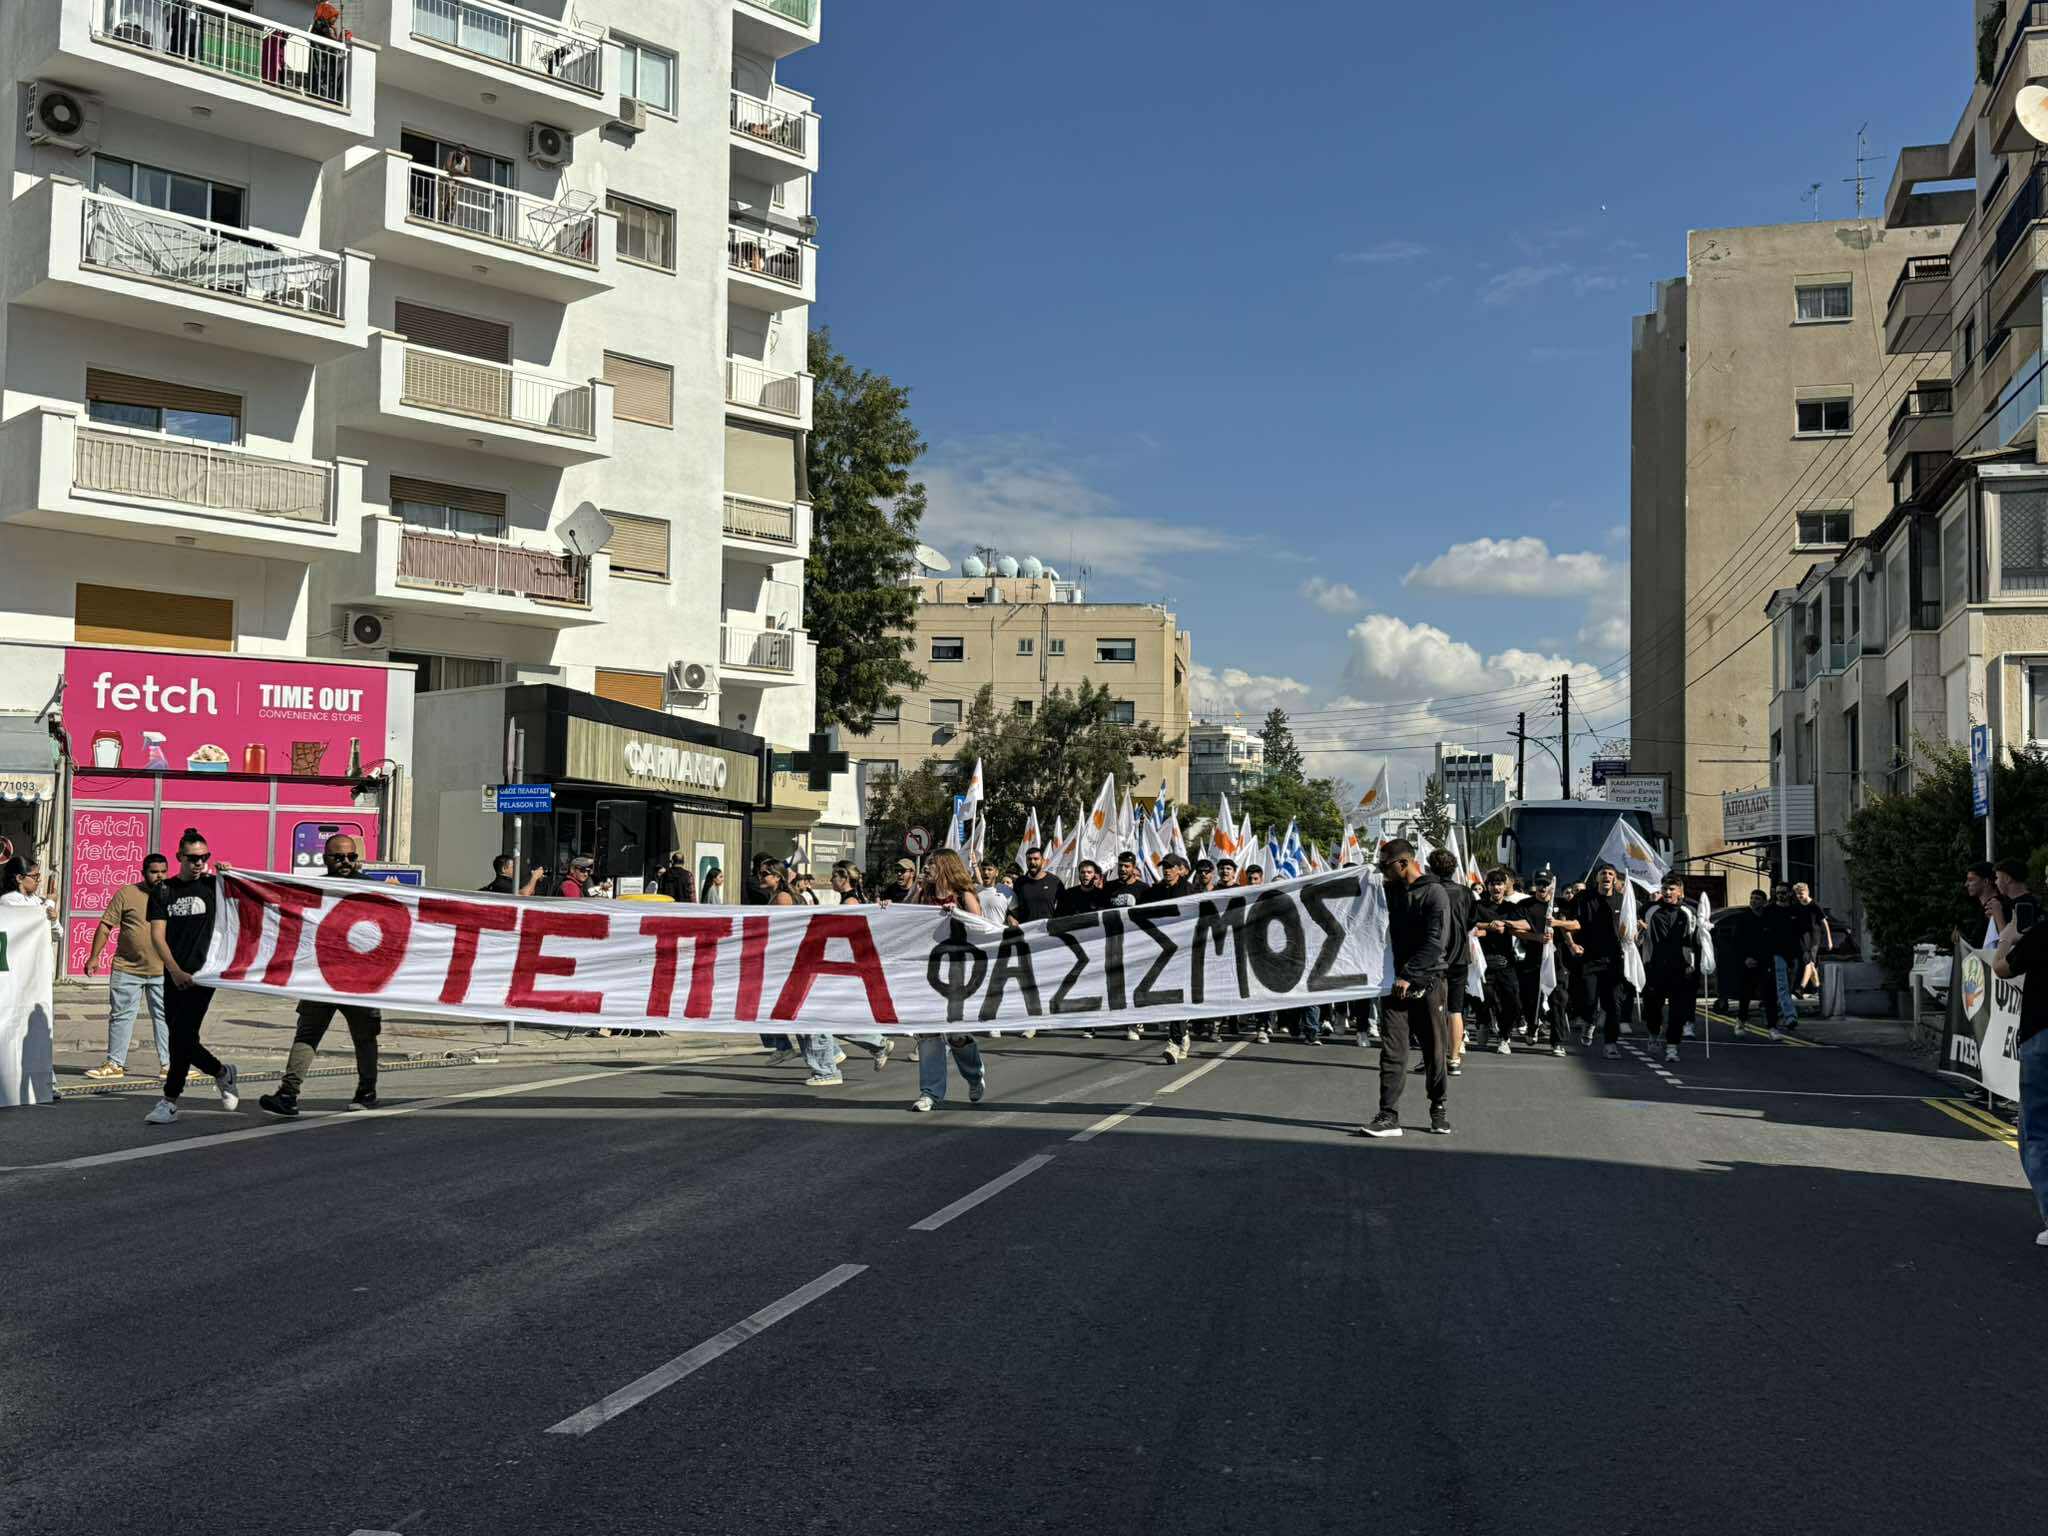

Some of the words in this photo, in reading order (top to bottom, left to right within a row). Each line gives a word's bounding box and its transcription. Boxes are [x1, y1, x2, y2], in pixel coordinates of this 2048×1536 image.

[93, 672, 217, 715] fetch
[260, 684, 314, 709] TIME
[320, 687, 363, 711] OUT
[259, 709, 329, 721] CONVENIENCE
[331, 712, 363, 722] STORE
[1725, 794, 1769, 817] ΑΠΟΛΛΩΝ
[78, 814, 144, 837] fetch
[77, 839, 143, 861] fetch
[220, 872, 610, 1012] ΠΟΤΕ
[641, 914, 898, 1023] ΠΙΑ
[926, 876, 1368, 1022] ΦΑΣΙΣΜΟΣ
